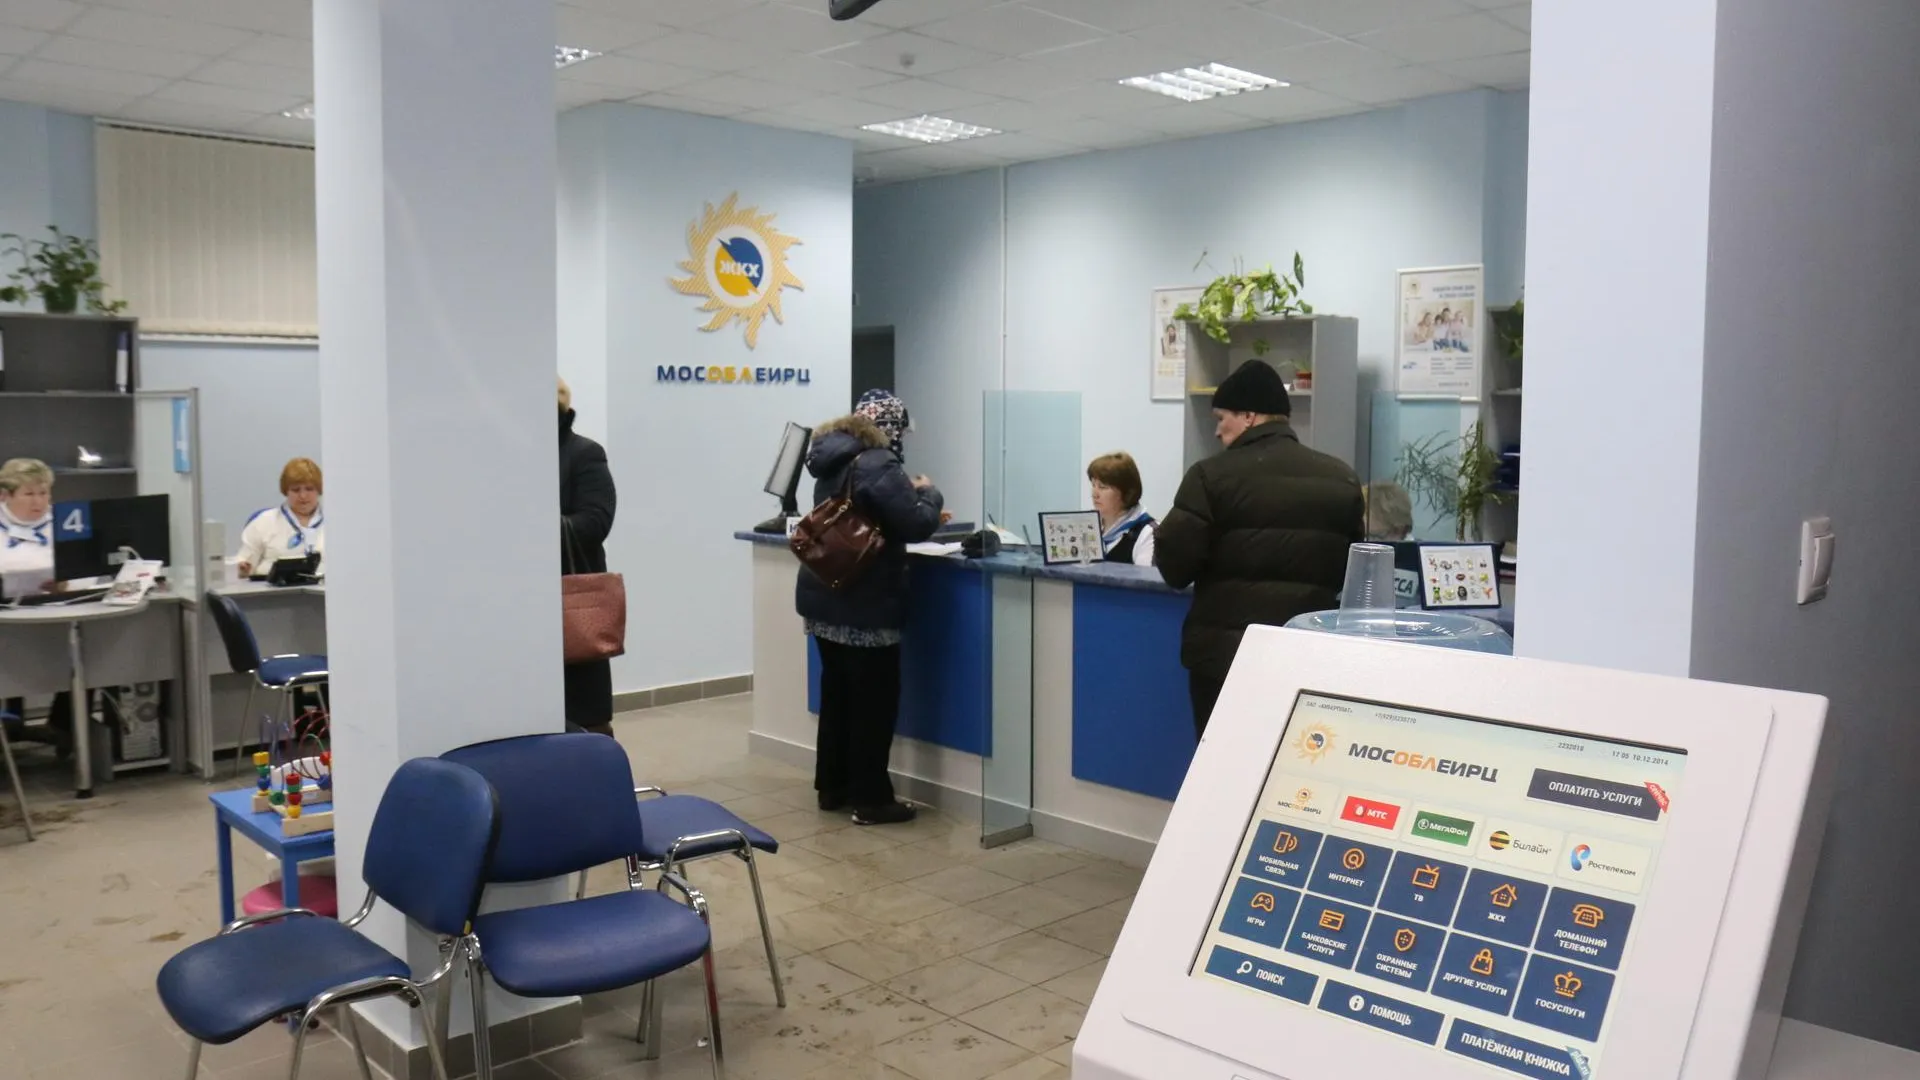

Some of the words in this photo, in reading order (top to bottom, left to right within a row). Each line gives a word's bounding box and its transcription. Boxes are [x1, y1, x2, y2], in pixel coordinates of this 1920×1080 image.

[719, 259, 760, 278] ЖКХ
[656, 364, 811, 384] МОСОБЛЕИРЦ
[62, 509, 85, 534] 4
[1348, 742, 1499, 783] МОСОБЛЕИРЦ
[1633, 754, 1669, 766] 10.12.2014
[1548, 781, 1600, 799] ОПЛАТИТЬ
[1601, 790, 1643, 807] УСЛУГИ
[1366, 807, 1389, 820] МТС
[1512, 839, 1549, 855] Билайн
[1258, 855, 1299, 870] МОБИЛЬНАЯ
[1264, 865, 1286, 876] СВЯЗЬ
[1588, 860, 1637, 877] Ростелеком
[1328, 872, 1365, 887] ИНТЕРНЕТ
[1413, 893, 1424, 902] ТВ
[1246, 915, 1266, 927] ИГРЫ
[1488, 912, 1506, 923] ЖКХ
[1301, 931, 1347, 950] БАНКОВСКИЕ
[1554, 928, 1607, 949] ДОМАШНИЙ
[1559, 939, 1598, 956] ТЕЛЕФОН
[1306, 941, 1336, 957] УСЛУГИ
[1375, 961, 1412, 979] СИСТЕМЫ
[1376, 953, 1418, 971] ОХРАННЫЕ
[1255, 968, 1286, 986] ПОИСК
[1442, 971, 1475, 989] ДРУГИЕ
[1475, 978, 1508, 997] УСЛУГИ
[1369, 1003, 1412, 1026] ПОМОЩЬ
[1535, 997, 1586, 1019] ГОСУСЛУГИ
[1460, 1032, 1525, 1062] ПЛАТЁЖНАЯ
[1524, 1053, 1571, 1077] КНИЖКА
